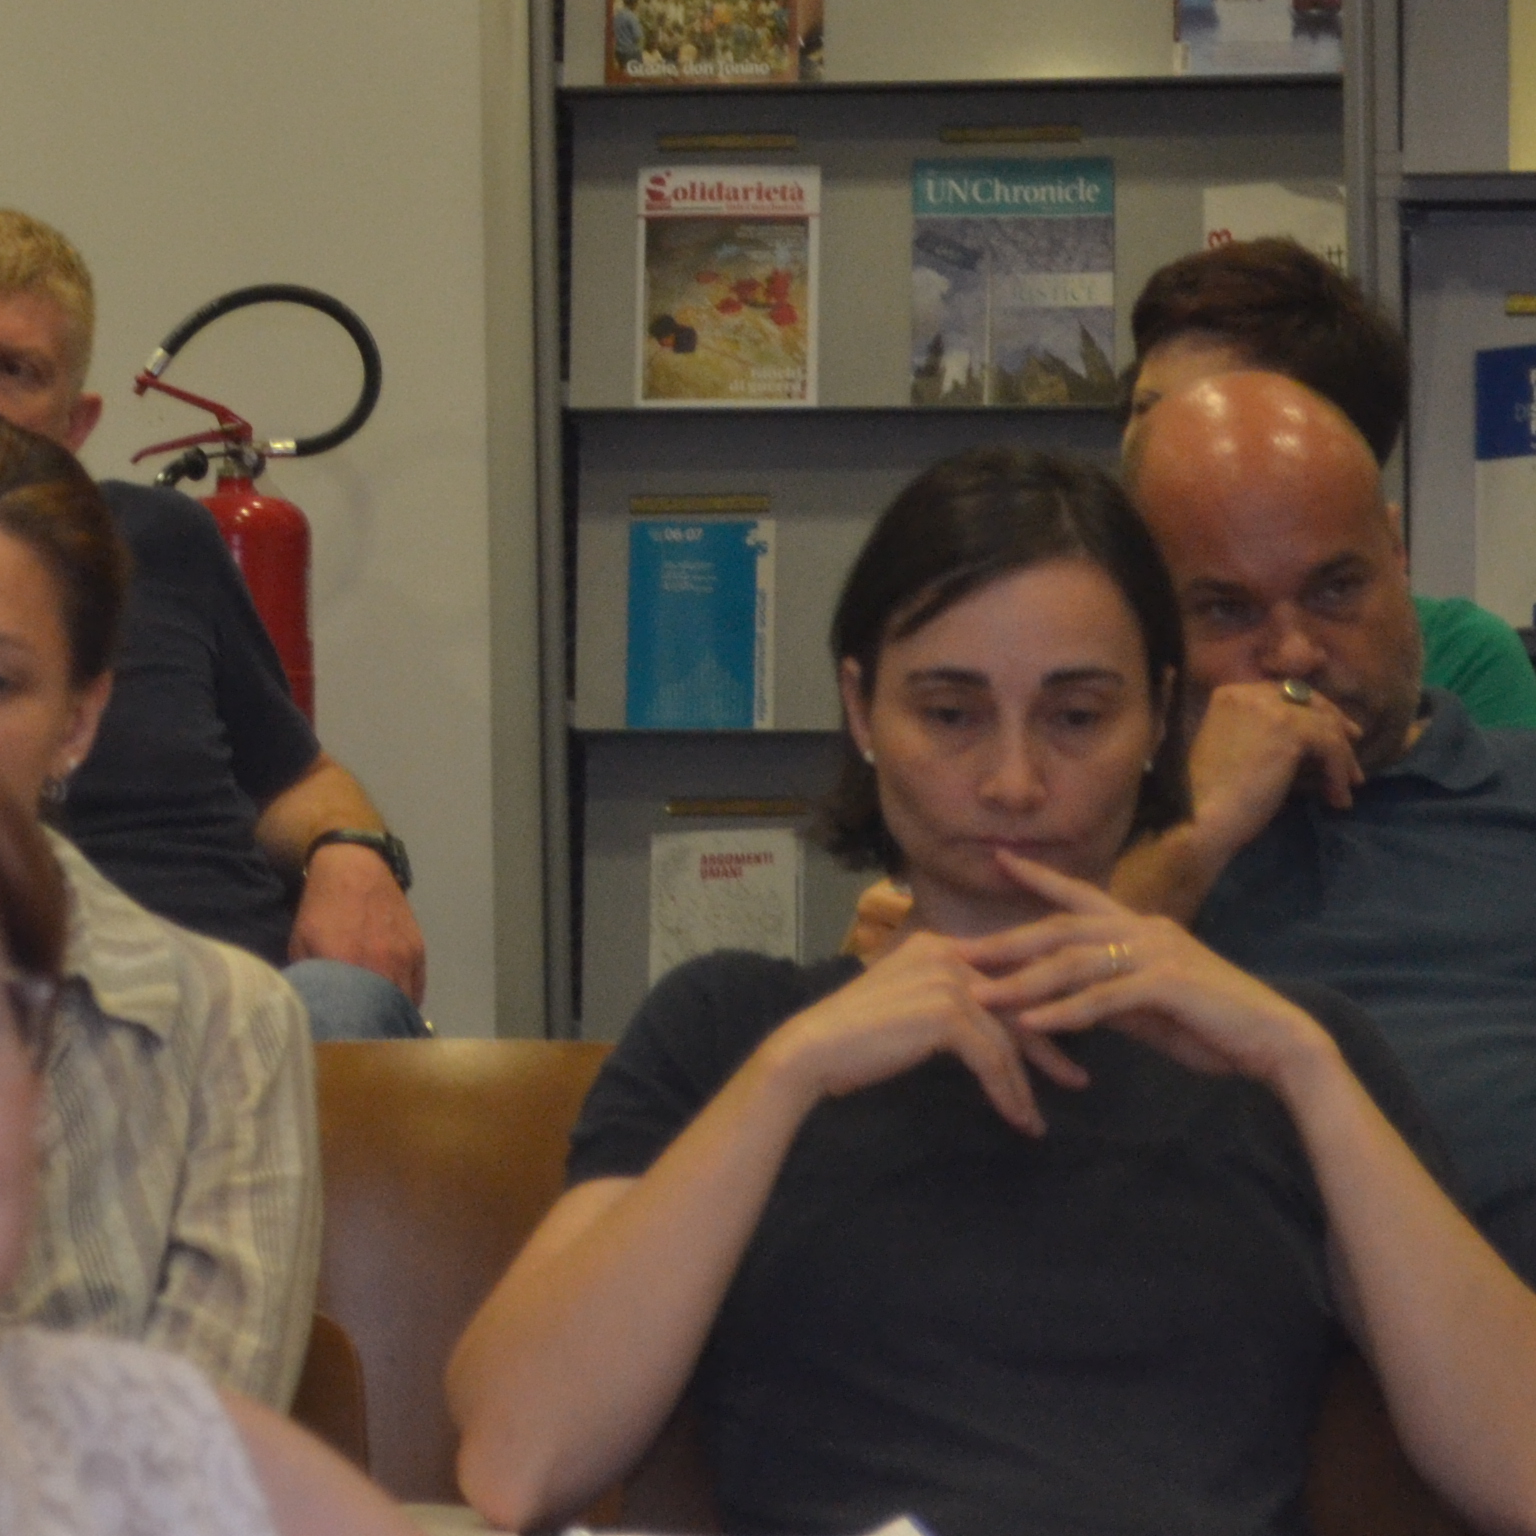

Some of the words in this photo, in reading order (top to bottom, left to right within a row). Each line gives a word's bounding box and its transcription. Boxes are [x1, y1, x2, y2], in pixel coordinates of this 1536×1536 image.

[645, 170, 805, 204] Solidarietà
[926, 177, 969, 204] UN
[972, 176, 1101, 204] Chronicle
